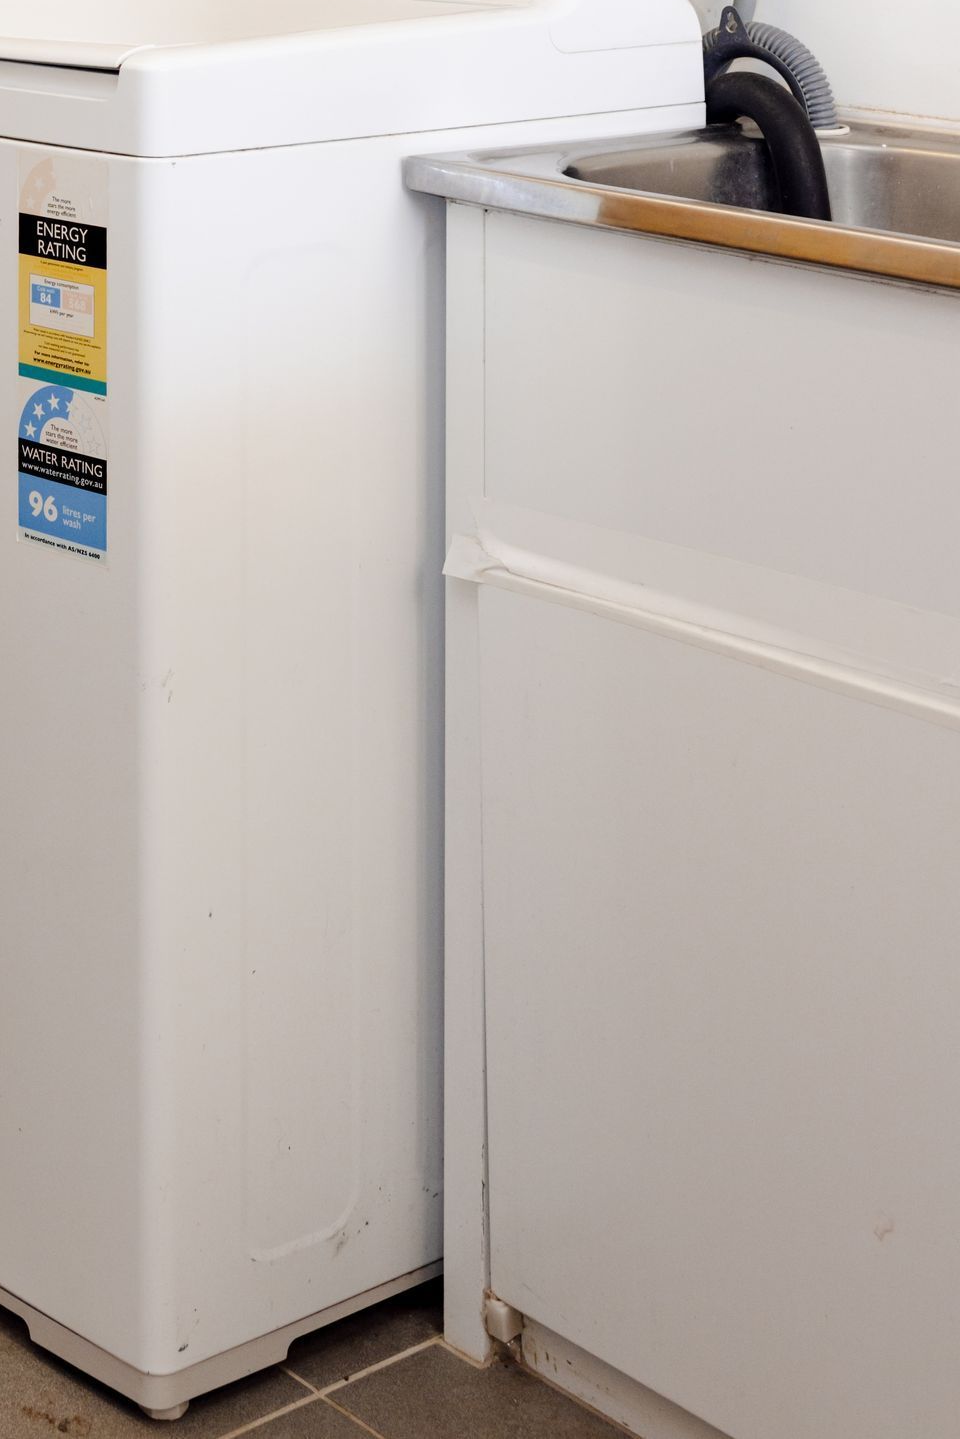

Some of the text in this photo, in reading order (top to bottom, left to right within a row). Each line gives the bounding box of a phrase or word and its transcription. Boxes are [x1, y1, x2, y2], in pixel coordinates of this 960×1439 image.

[36, 220, 88, 244] ENERGY
[38, 239, 87, 262] RATING
[40, 292, 52, 305] 84
[33, 357, 91, 374] www.energyrating.gov.au
[51, 424, 60, 432] The
[59, 441, 78, 449] efficient
[21, 444, 103, 478] WATER RATING
[21, 461, 103, 489] www.waterrating.gov.au
[29, 490, 58, 522] 96
[62, 505, 96, 523] litres per
[62, 518, 81, 529] wash
